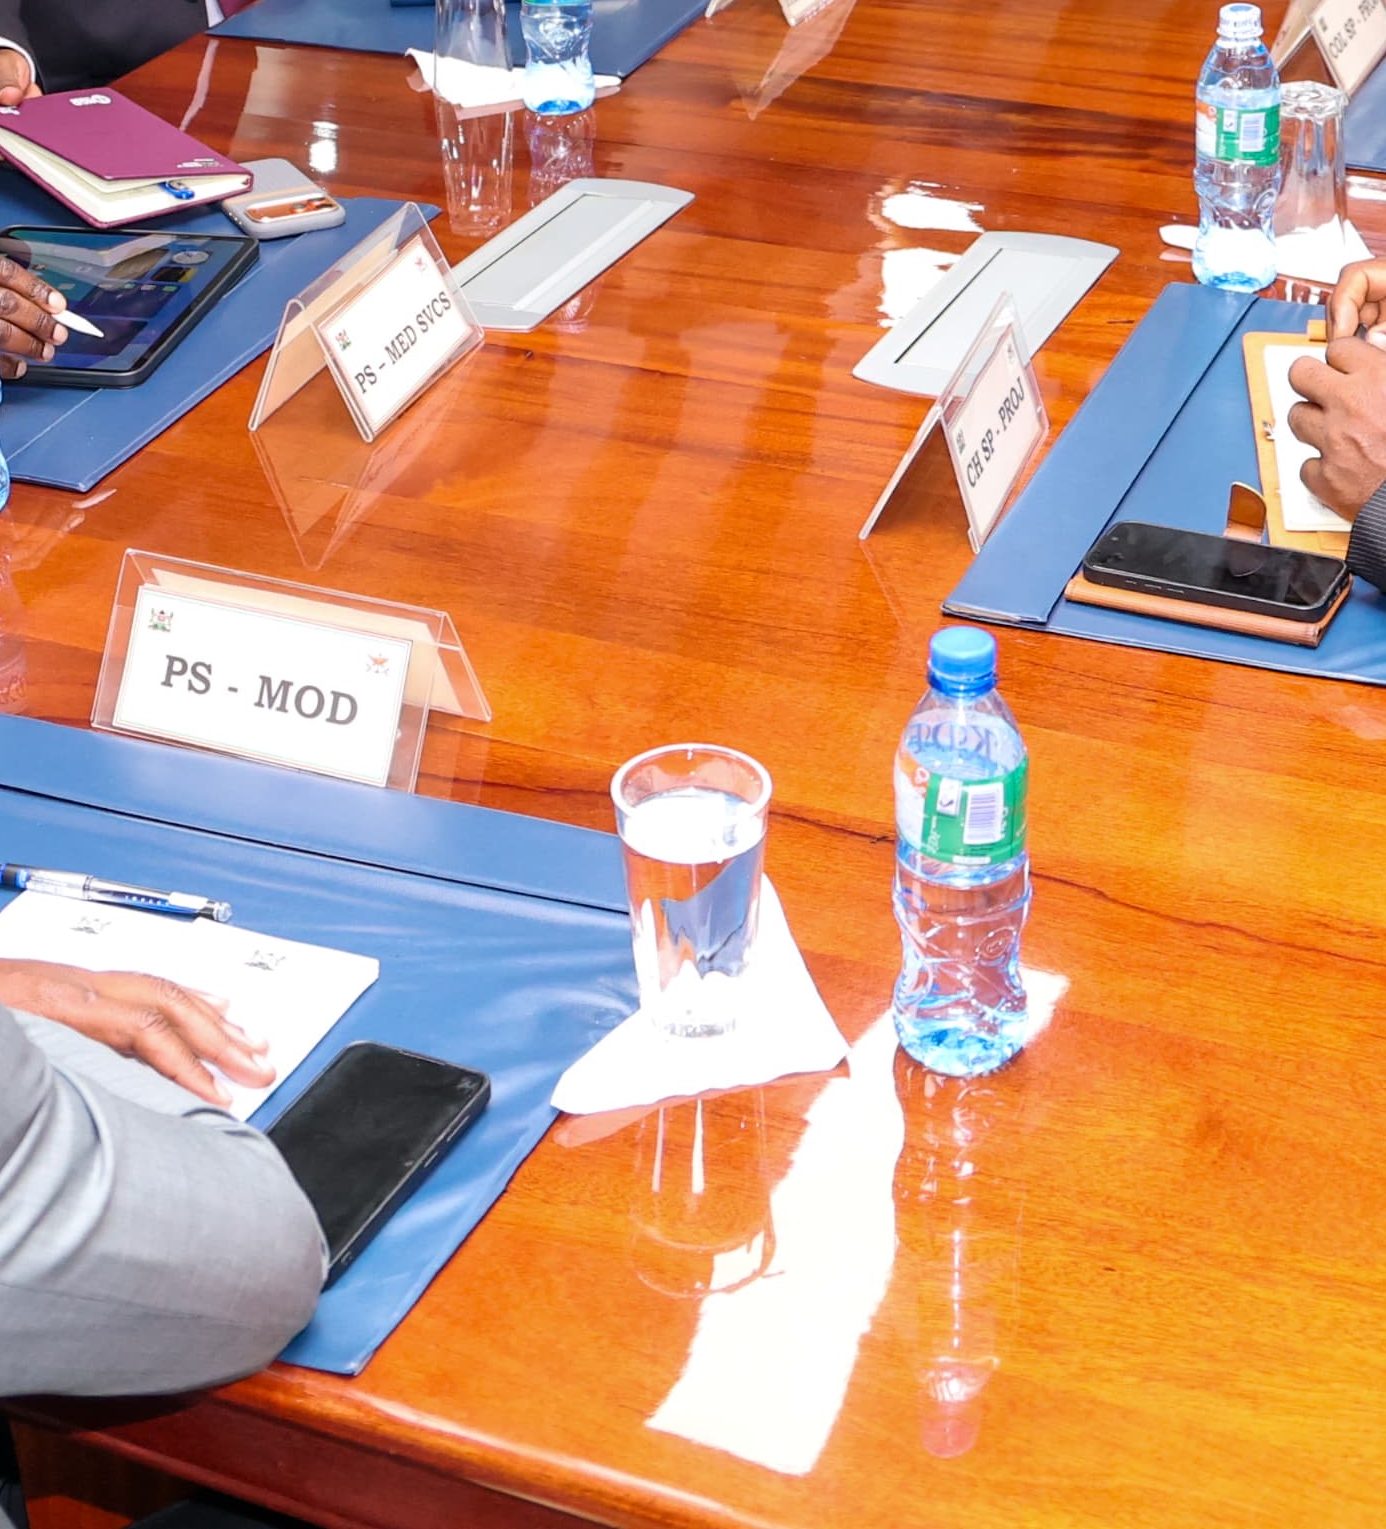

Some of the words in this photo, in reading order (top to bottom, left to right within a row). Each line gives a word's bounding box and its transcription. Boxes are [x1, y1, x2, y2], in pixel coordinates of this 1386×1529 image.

[354, 364, 378, 394] PS
[384, 324, 418, 365] MED
[416, 290, 453, 333] SVCS
[966, 451, 983, 487] CH
[981, 429, 995, 462] SP
[999, 377, 1025, 431] PROJ
[160, 654, 213, 695] PS
[254, 674, 360, 726] MOD
